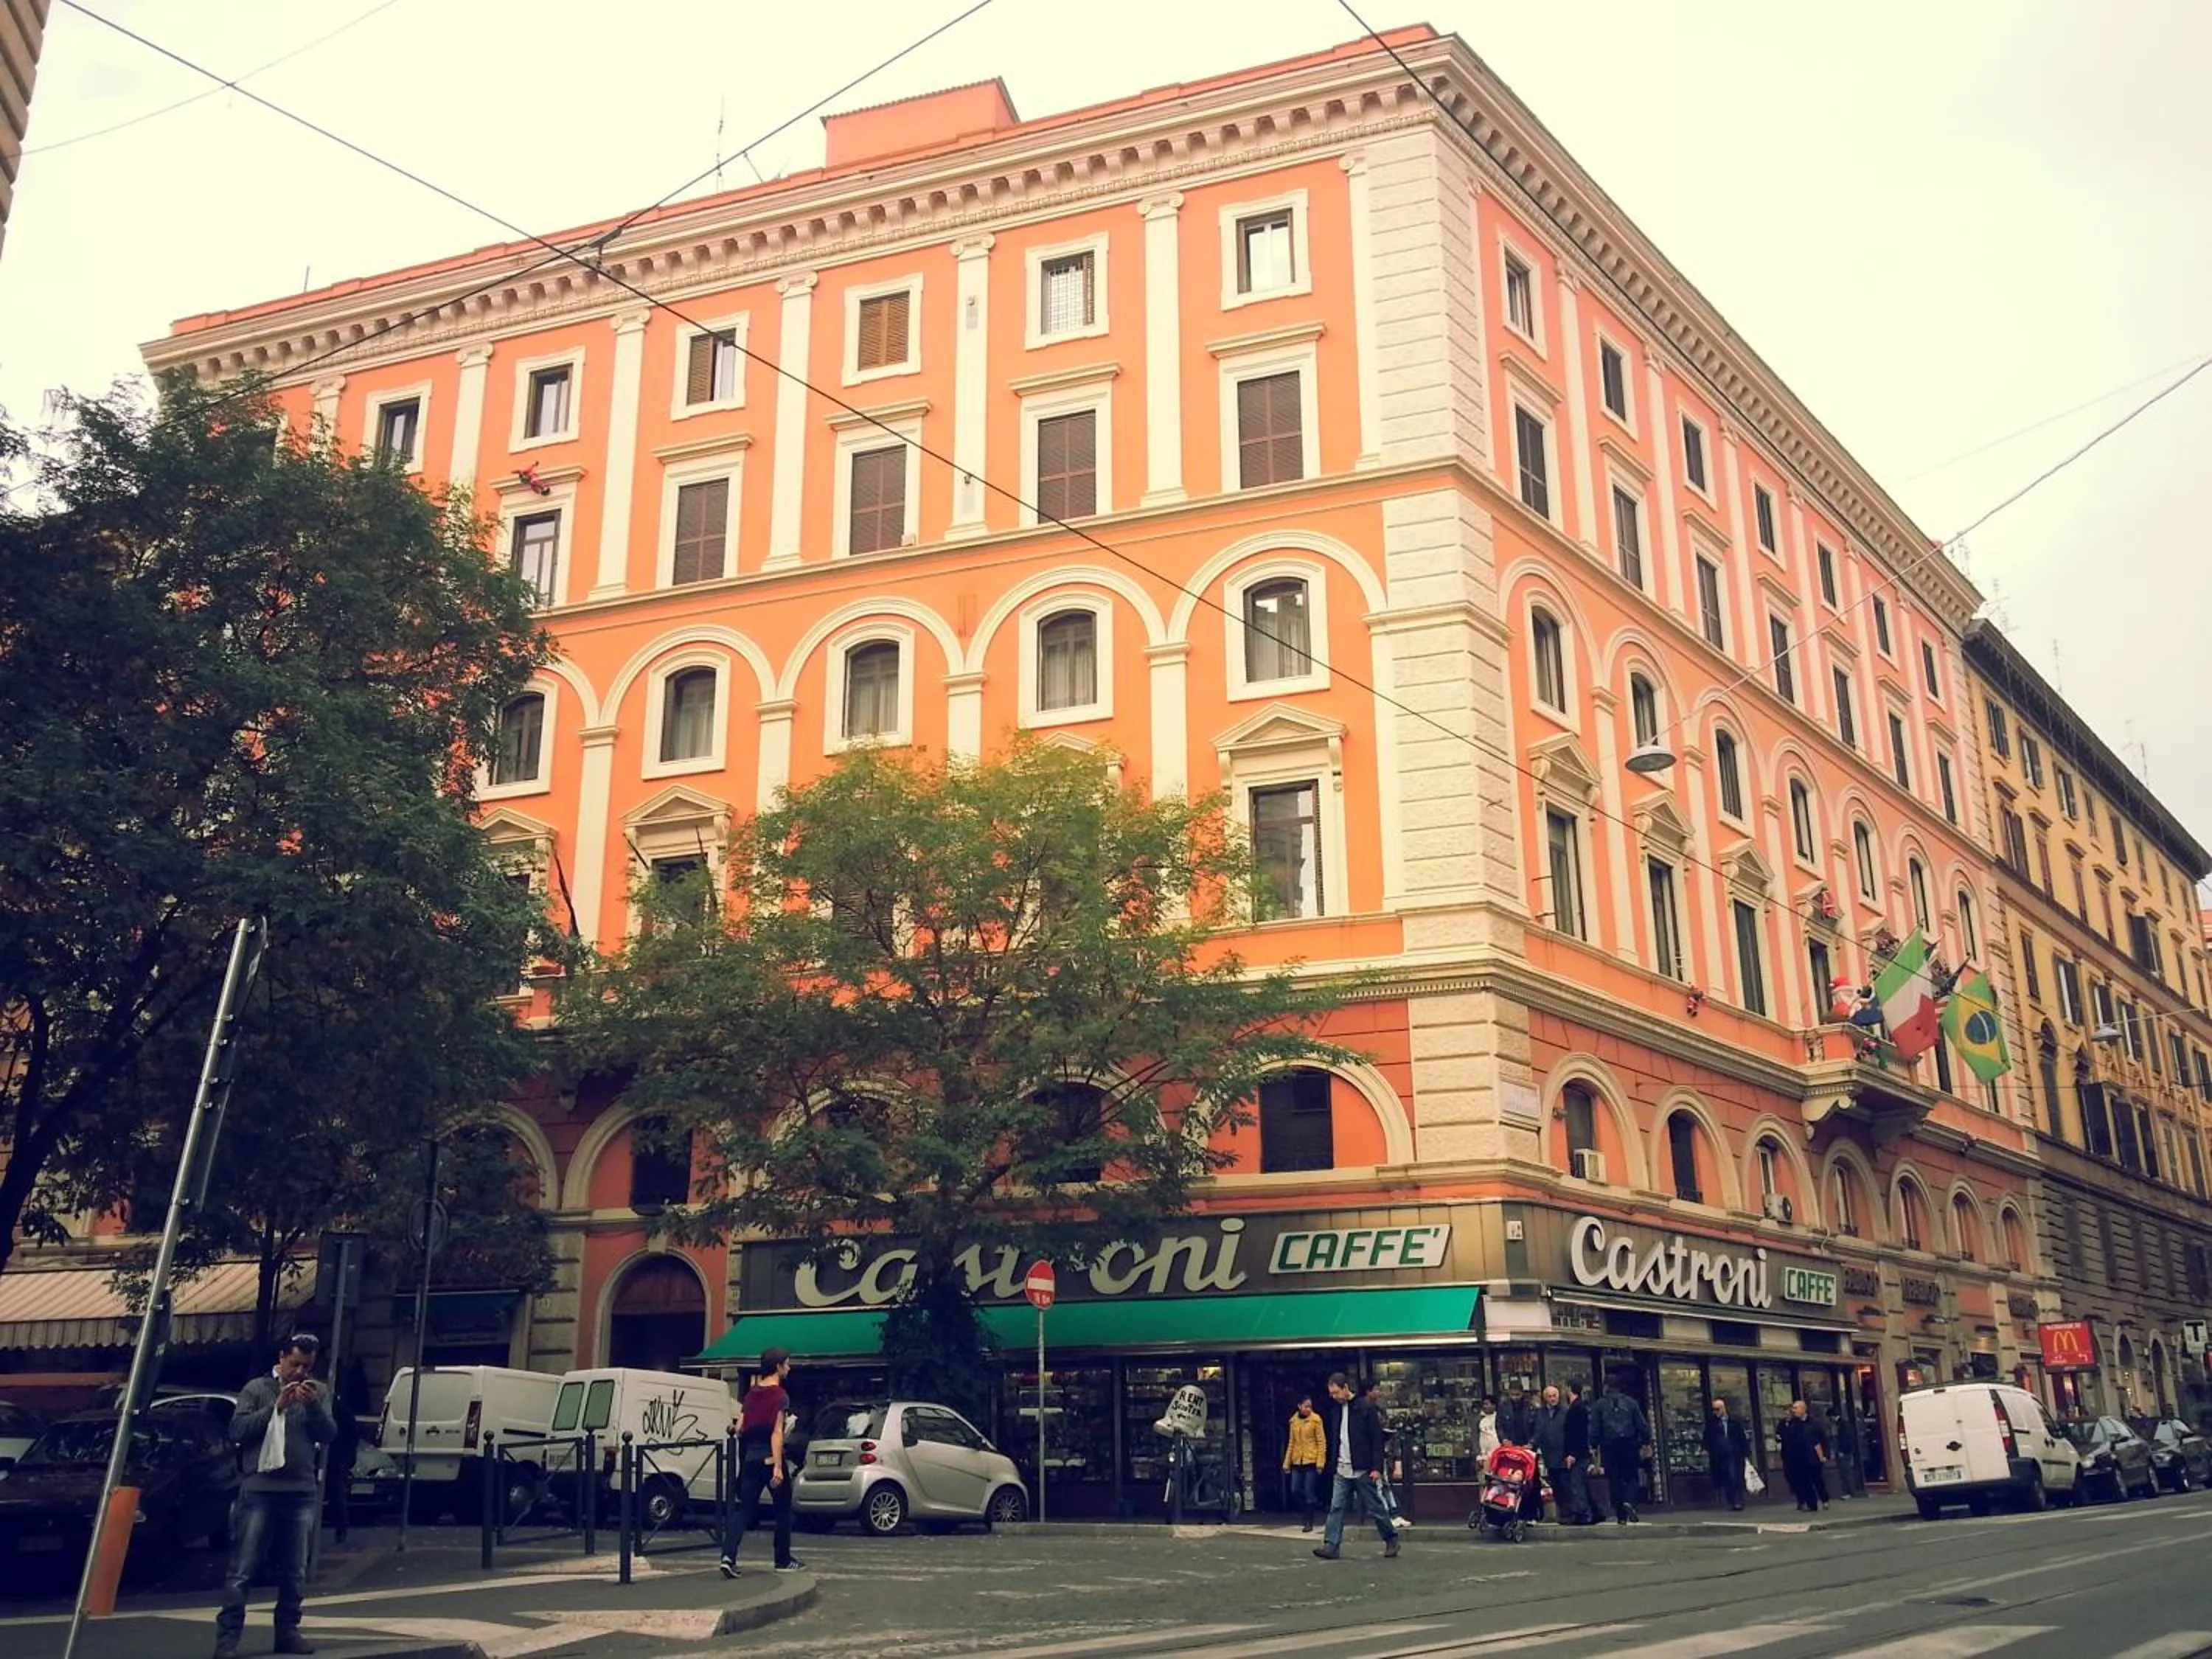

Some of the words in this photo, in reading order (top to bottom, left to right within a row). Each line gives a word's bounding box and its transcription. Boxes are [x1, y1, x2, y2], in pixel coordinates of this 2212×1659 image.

[795, 1217, 1247, 1307] Castoni
[1571, 1217, 1771, 1309] Castroni
[1180, 1391, 1204, 1408] RENT
